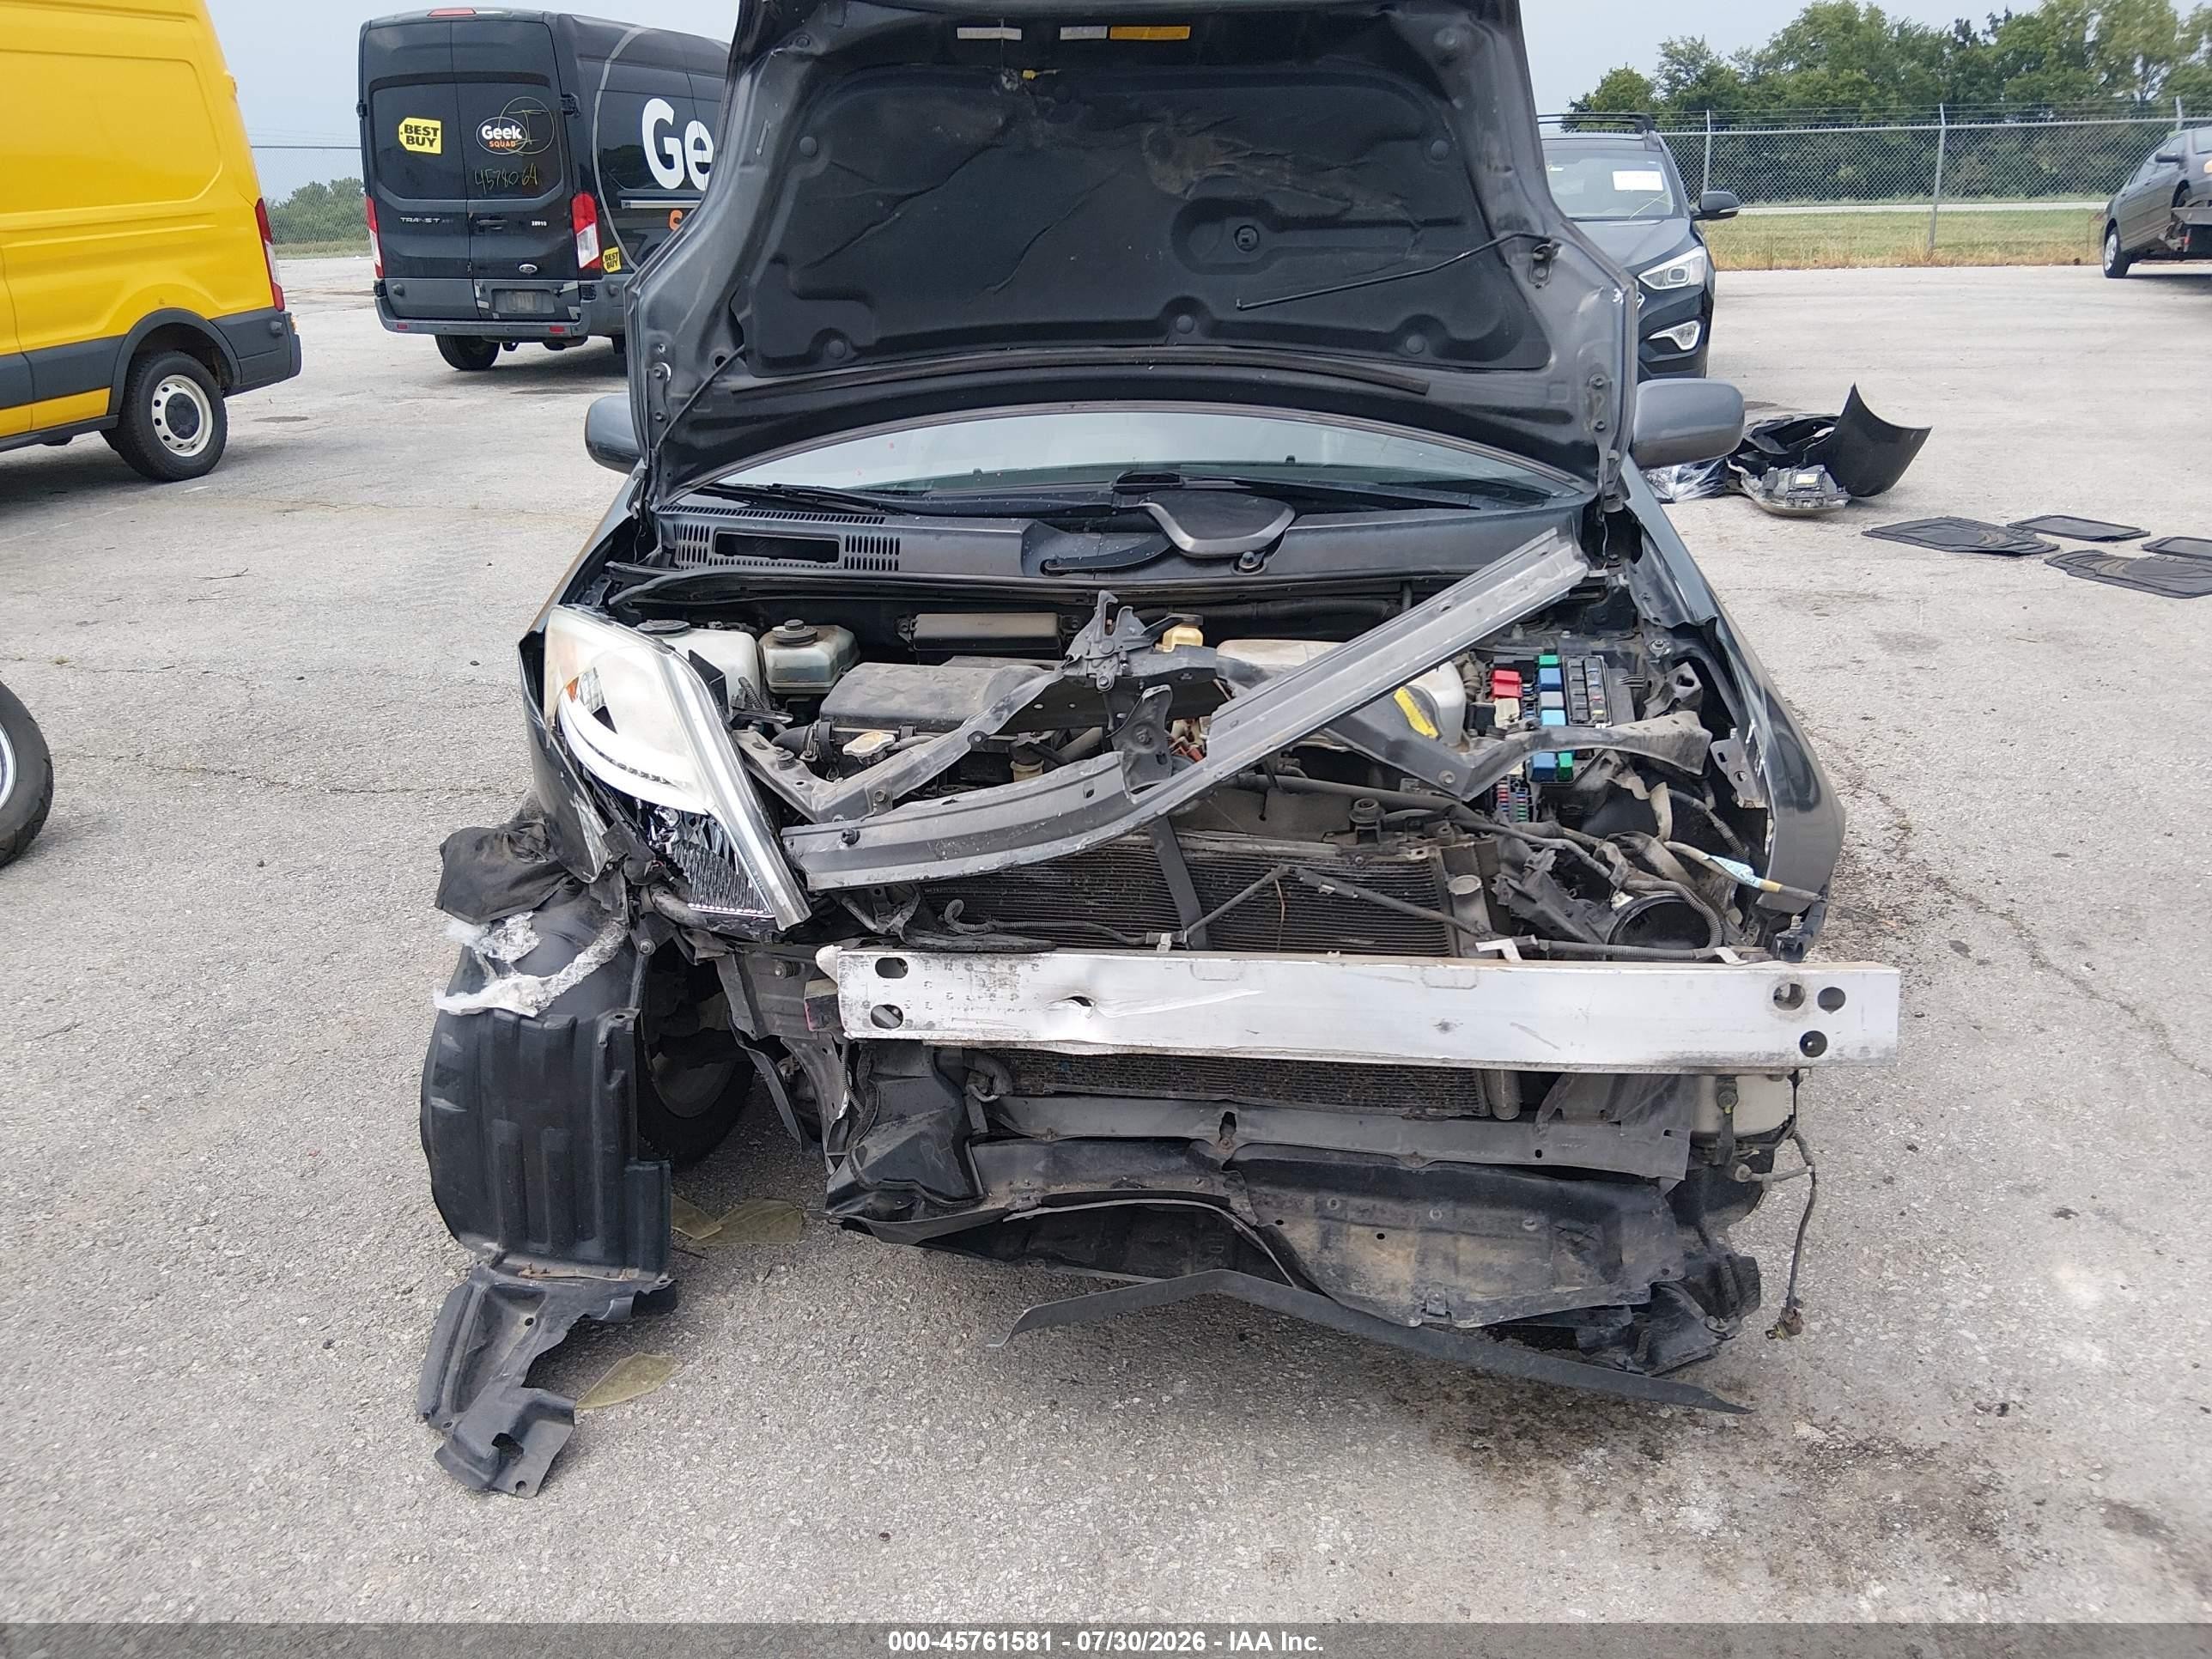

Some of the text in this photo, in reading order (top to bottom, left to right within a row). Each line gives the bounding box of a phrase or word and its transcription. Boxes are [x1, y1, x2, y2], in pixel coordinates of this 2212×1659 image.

[404, 124, 439, 137] BEST
[481, 125, 523, 140] Geek
[405, 135, 437, 148] BUY
[489, 140, 516, 149] SQUAD
[604, 252, 618, 262] BEST
[606, 260, 618, 270] BUY
